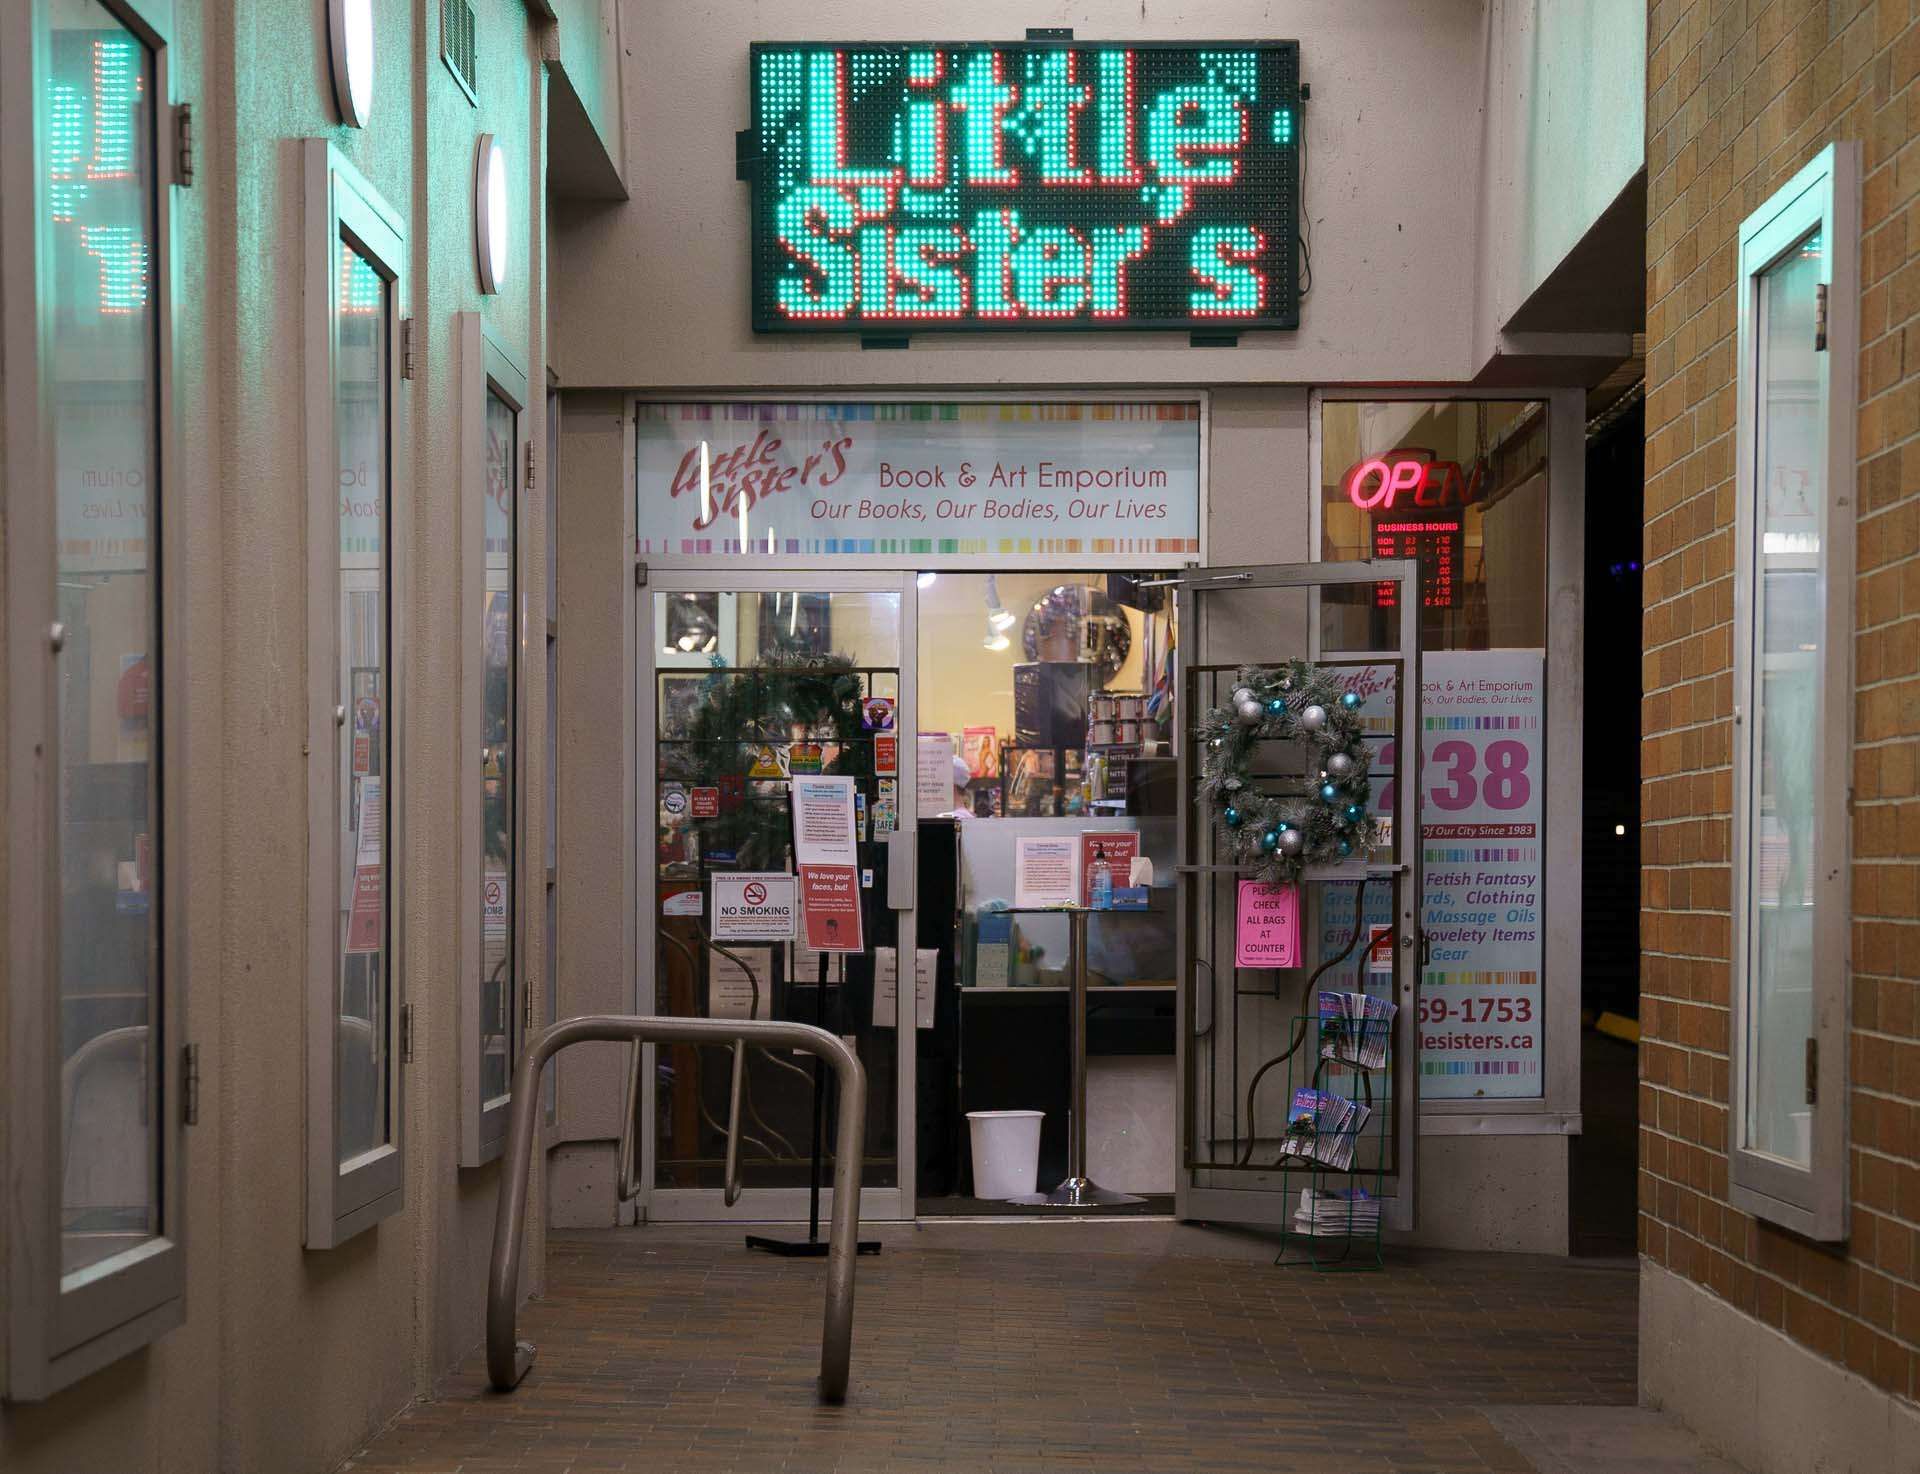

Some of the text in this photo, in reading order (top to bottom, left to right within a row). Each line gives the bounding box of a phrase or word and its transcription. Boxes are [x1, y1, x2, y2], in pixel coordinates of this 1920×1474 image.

[809, 50, 1251, 185] Little
[777, 183, 1268, 319] Sister's
[879, 462, 1168, 492] Book & Art Emporium
[1349, 461, 1483, 509] OPEN
[810, 499, 1168, 522] Our Books, Our Bodies, Our Lives
[1377, 522, 1459, 532] BUSINESS HOURS
[1421, 680, 1533, 693] ook & Art Emporium
[1436, 695, 1454, 704] Our
[1490, 695, 1508, 704] Our
[1510, 694, 1534, 704] Lives
[876, 820, 893, 831] SAFE
[1437, 825, 1456, 837] Our
[1457, 825, 1477, 838] City
[1479, 825, 1505, 837] Since
[1507, 825, 1533, 837] 1983
[807, 872, 850, 882] We love your
[1425, 872, 1536, 888] Fetish Fantasy
[811, 882, 833, 892] faces,
[1253, 900, 1280, 910] CHECK
[1423, 890, 1456, 908] rds,
[1466, 890, 1536, 907] Clothing
[721, 906, 790, 915] NO SMOKING
[1246, 916, 1286, 925] ALL BAGS
[1425, 910, 1497, 926] Massage
[1506, 909, 1536, 922] Oils
[1260, 930, 1271, 939] AT
[1492, 928, 1536, 942] Items
[1244, 943, 1285, 953] COUNTER
[1430, 947, 1471, 961] Gear
